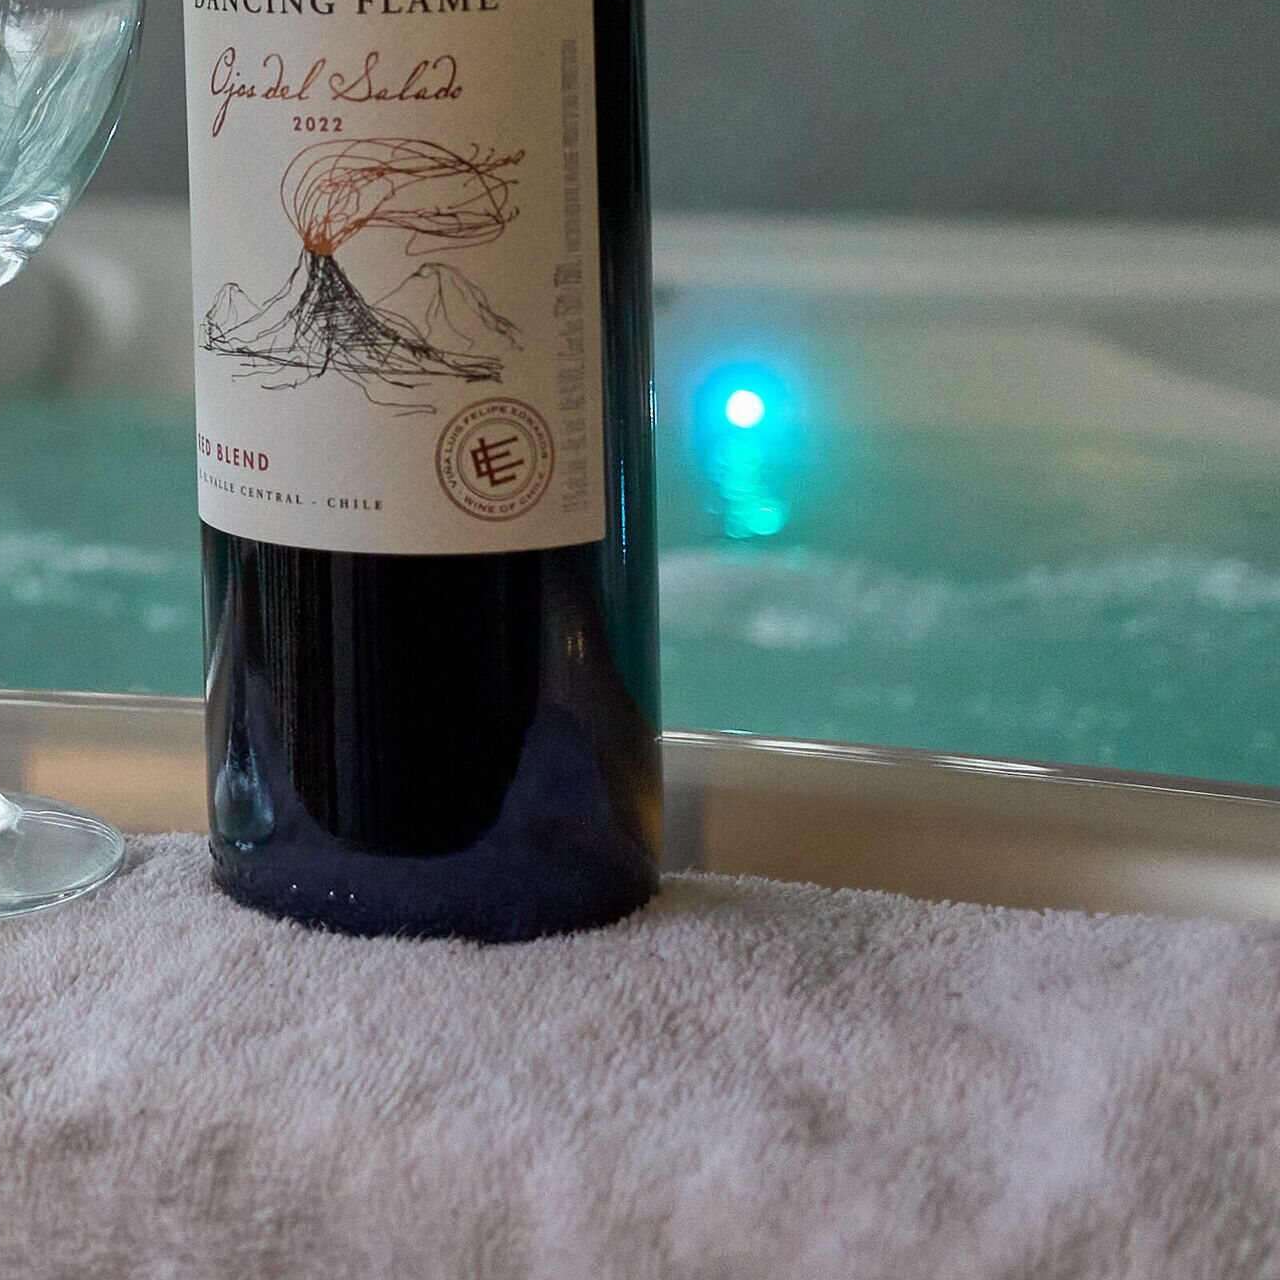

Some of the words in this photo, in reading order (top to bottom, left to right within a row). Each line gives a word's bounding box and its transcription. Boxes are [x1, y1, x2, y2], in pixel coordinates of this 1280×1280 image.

[211, 47, 256, 137] Ojos
[263, 53, 326, 101] del
[329, 51, 462, 102] Salado
[293, 116, 343, 132] 2022
[217, 443, 269, 472] BLEND
[209, 475, 235, 493] VALLE
[240, 485, 302, 505] CENTRAL
[327, 497, 383, 511] CHILE
[464, 495, 496, 513] WINE
[500, 503, 515, 513] OF
